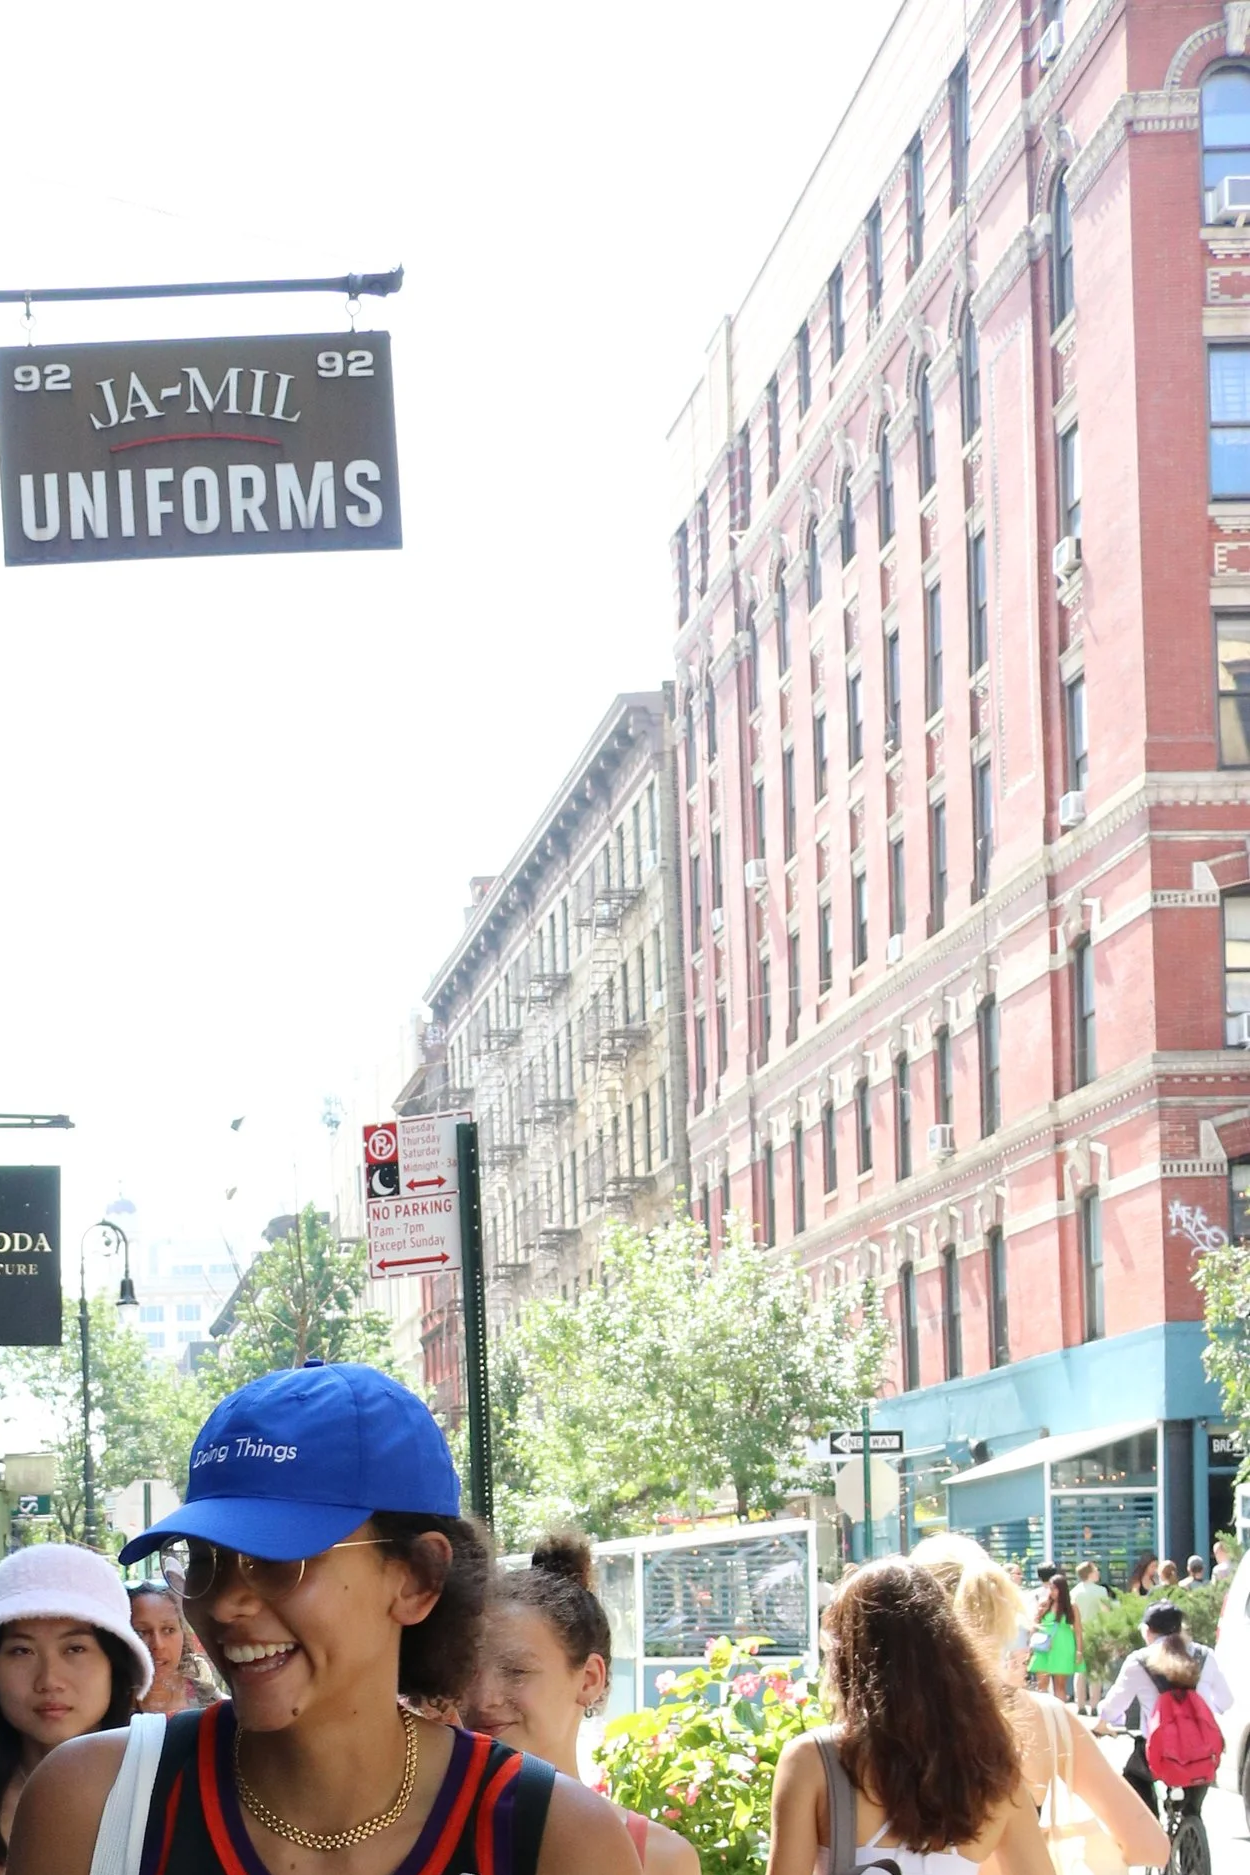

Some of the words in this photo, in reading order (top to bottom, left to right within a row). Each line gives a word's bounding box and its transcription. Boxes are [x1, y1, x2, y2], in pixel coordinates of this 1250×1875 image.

[317, 349, 374, 378] 92
[13, 363, 72, 392] 92
[89, 366, 302, 430] JA-MIL
[19, 459, 383, 542] UNIFORMS
[402, 1123, 436, 1135] Tuesday
[402, 1134, 441, 1147] Thursday
[403, 1146, 441, 1159] Saturday
[404, 1160, 439, 1173] Midnight
[446, 1158, 458, 1168] 3a
[372, 1206, 390, 1221] NO
[395, 1199, 452, 1219] PARKING
[374, 1226, 394, 1238] 7am
[404, 1223, 425, 1236] 7pm
[374, 1238, 406, 1252] Except
[410, 1234, 445, 1249] Sunday
[840, 1437, 862, 1448] ONE
[872, 1437, 894, 1447] WAY
[192, 1444, 229, 1469] Doing
[235, 1437, 298, 1462] Things
